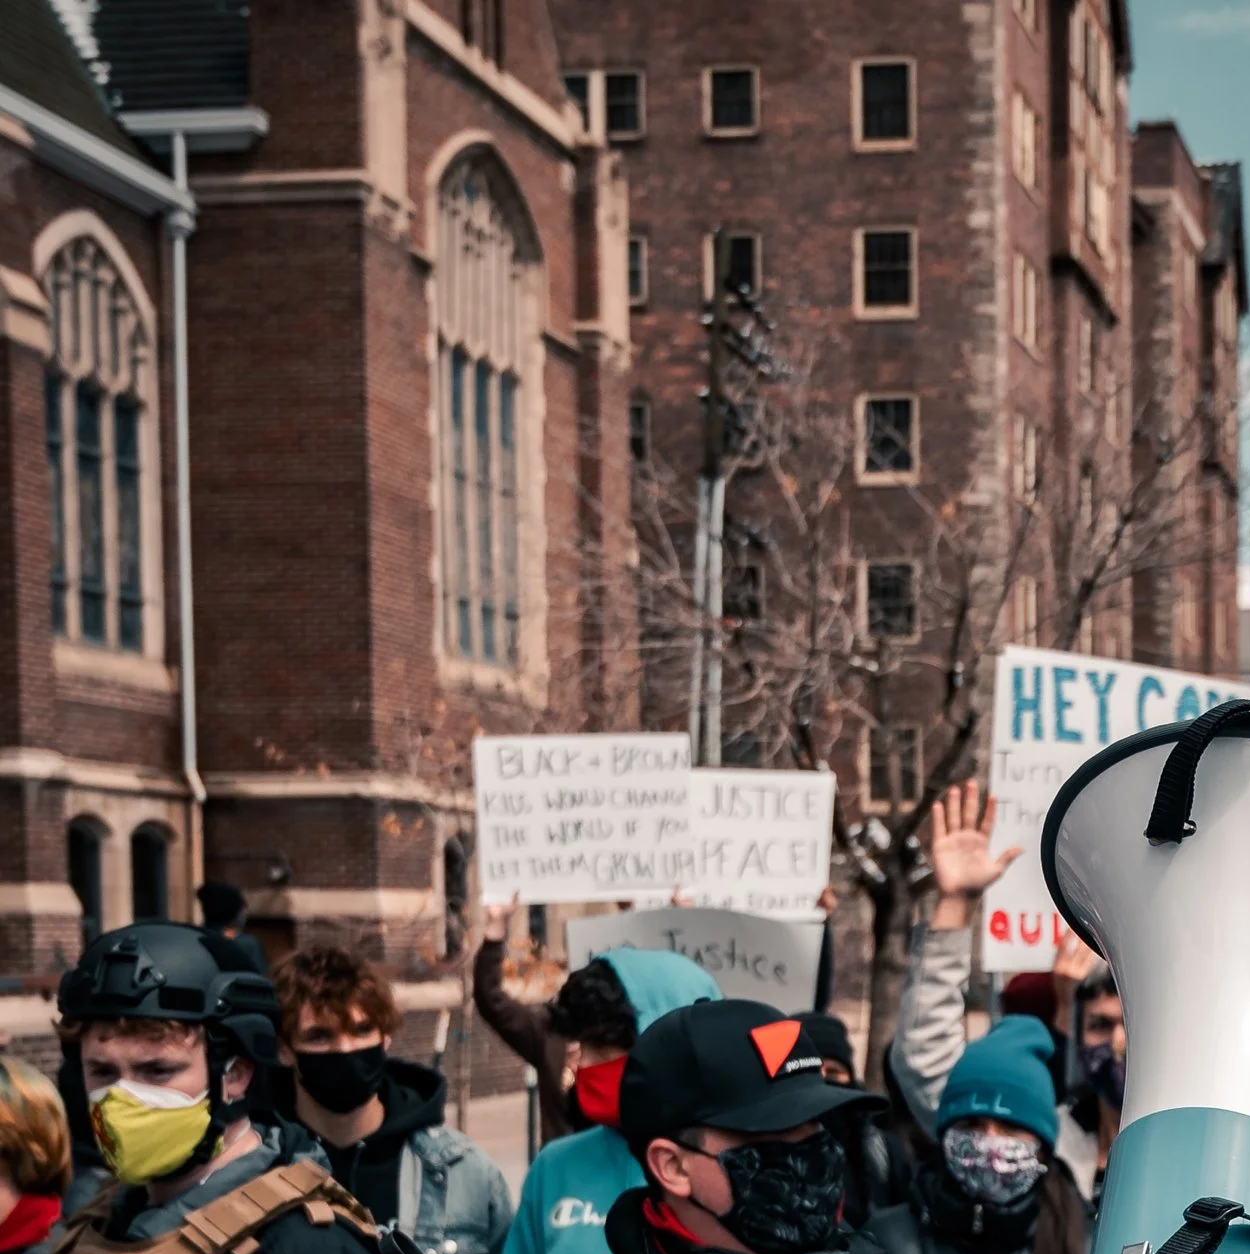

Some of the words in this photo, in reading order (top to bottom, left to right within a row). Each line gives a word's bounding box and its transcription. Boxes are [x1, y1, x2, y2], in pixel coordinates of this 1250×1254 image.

[1011, 665, 1117, 745] HEY
[497, 743, 580, 780] BLACK
[699, 782, 821, 822] JUSTICE
